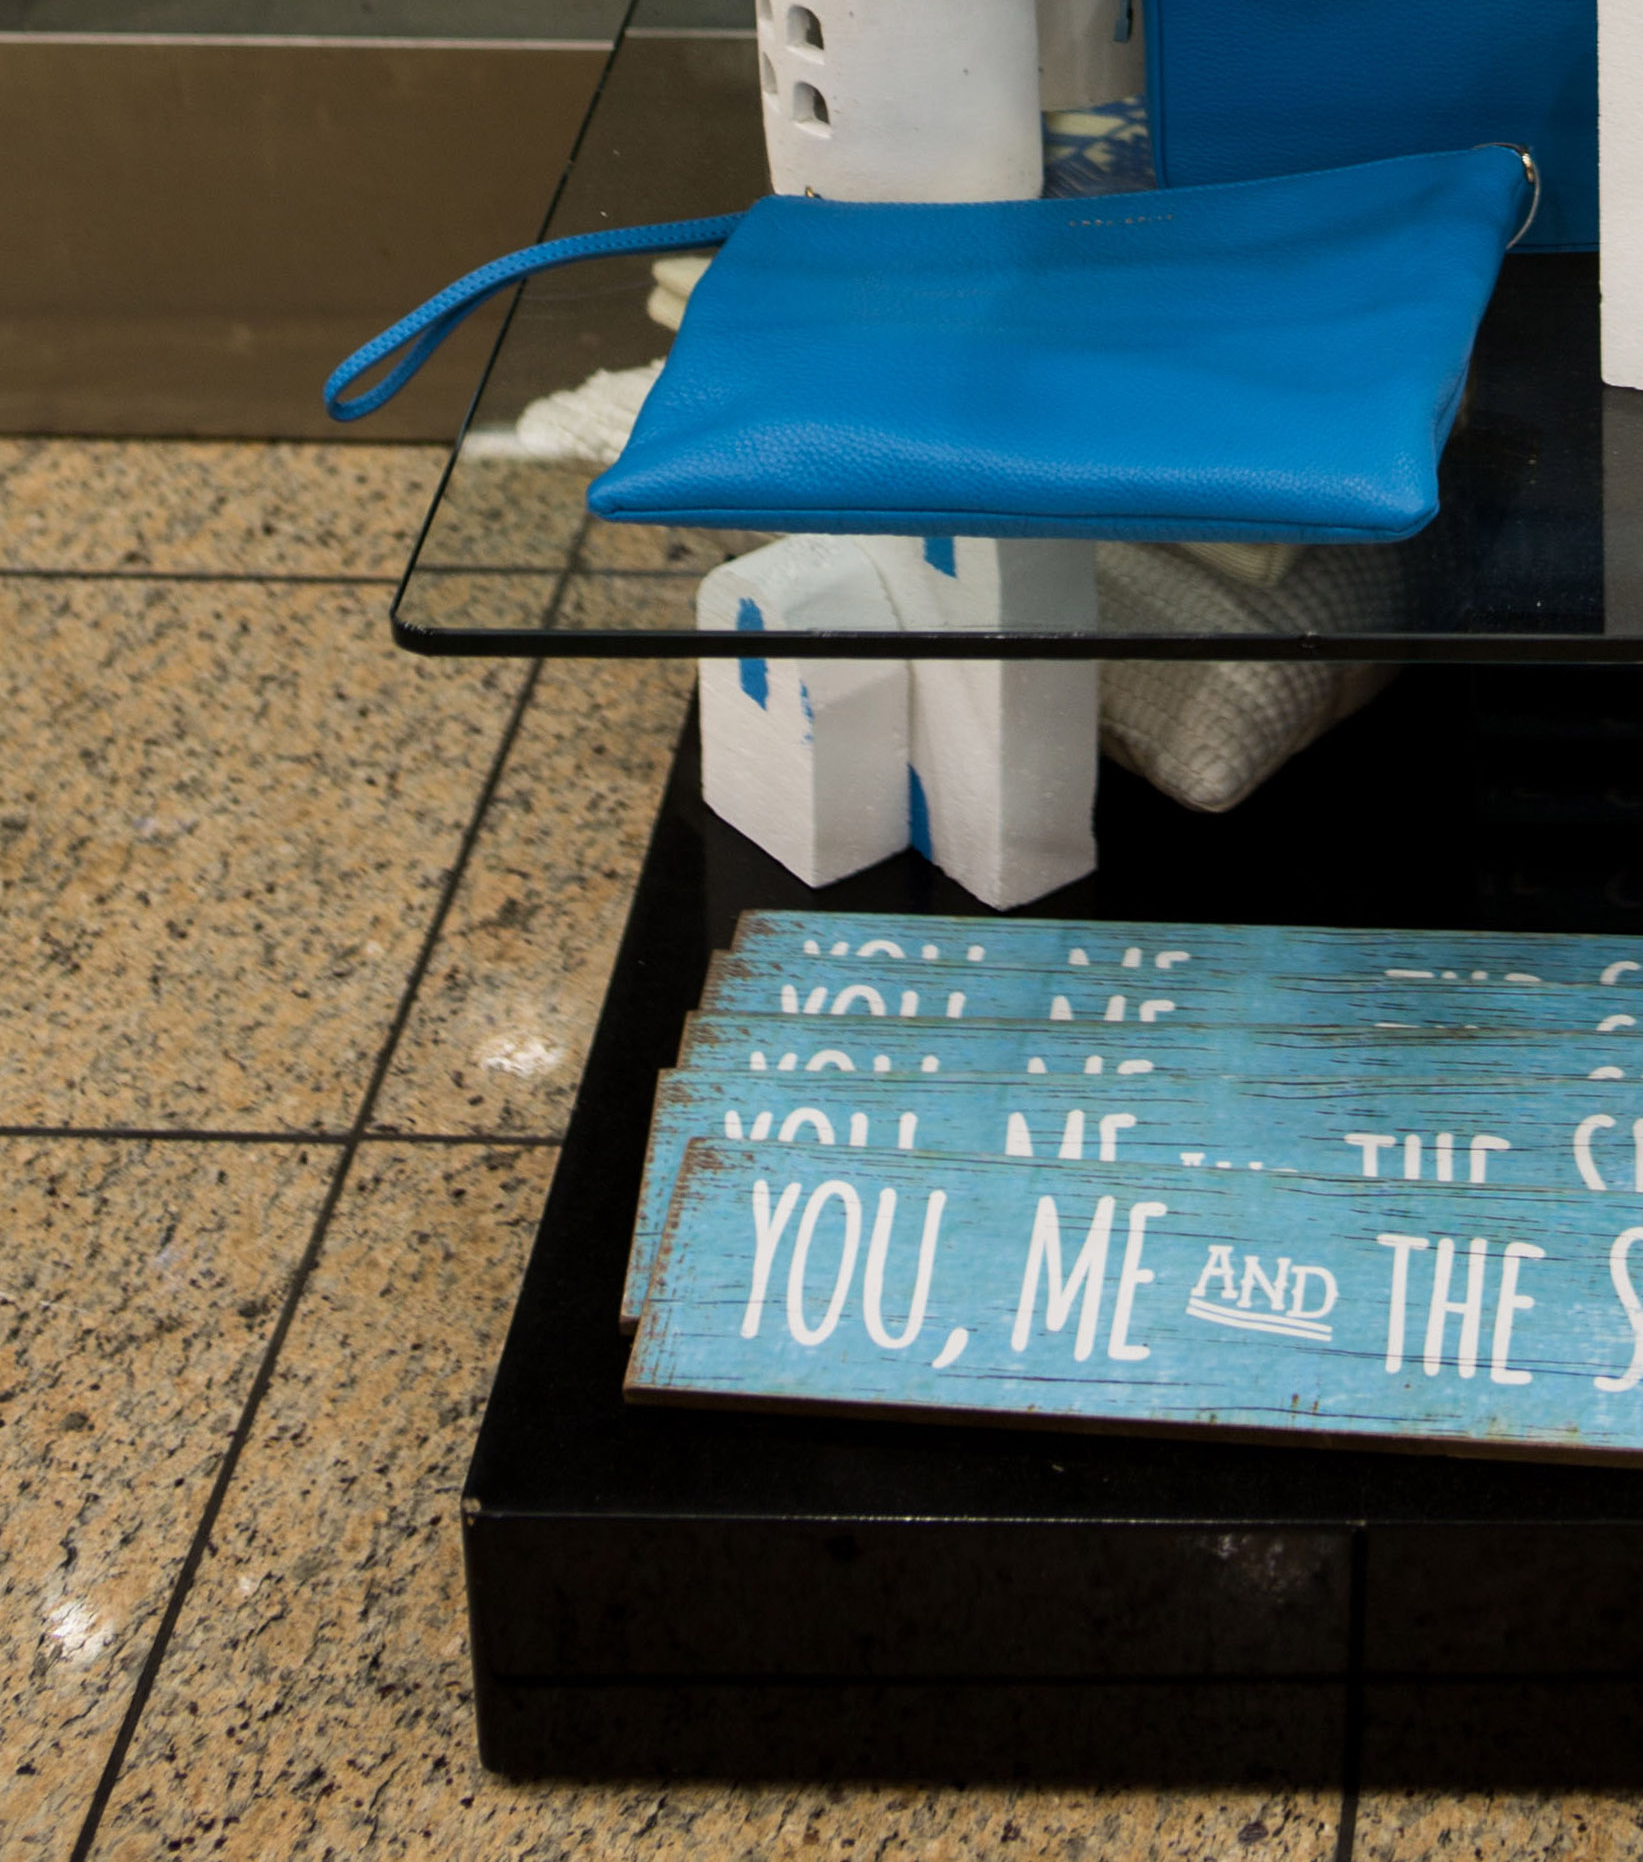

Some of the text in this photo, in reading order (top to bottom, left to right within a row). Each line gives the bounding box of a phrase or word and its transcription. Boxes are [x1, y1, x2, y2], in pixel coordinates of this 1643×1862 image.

[741, 1179, 968, 1369] YOU,
[1011, 1194, 1168, 1363] ME
[1190, 1244, 1339, 1320] AND
[1376, 1233, 1546, 1385] THE
